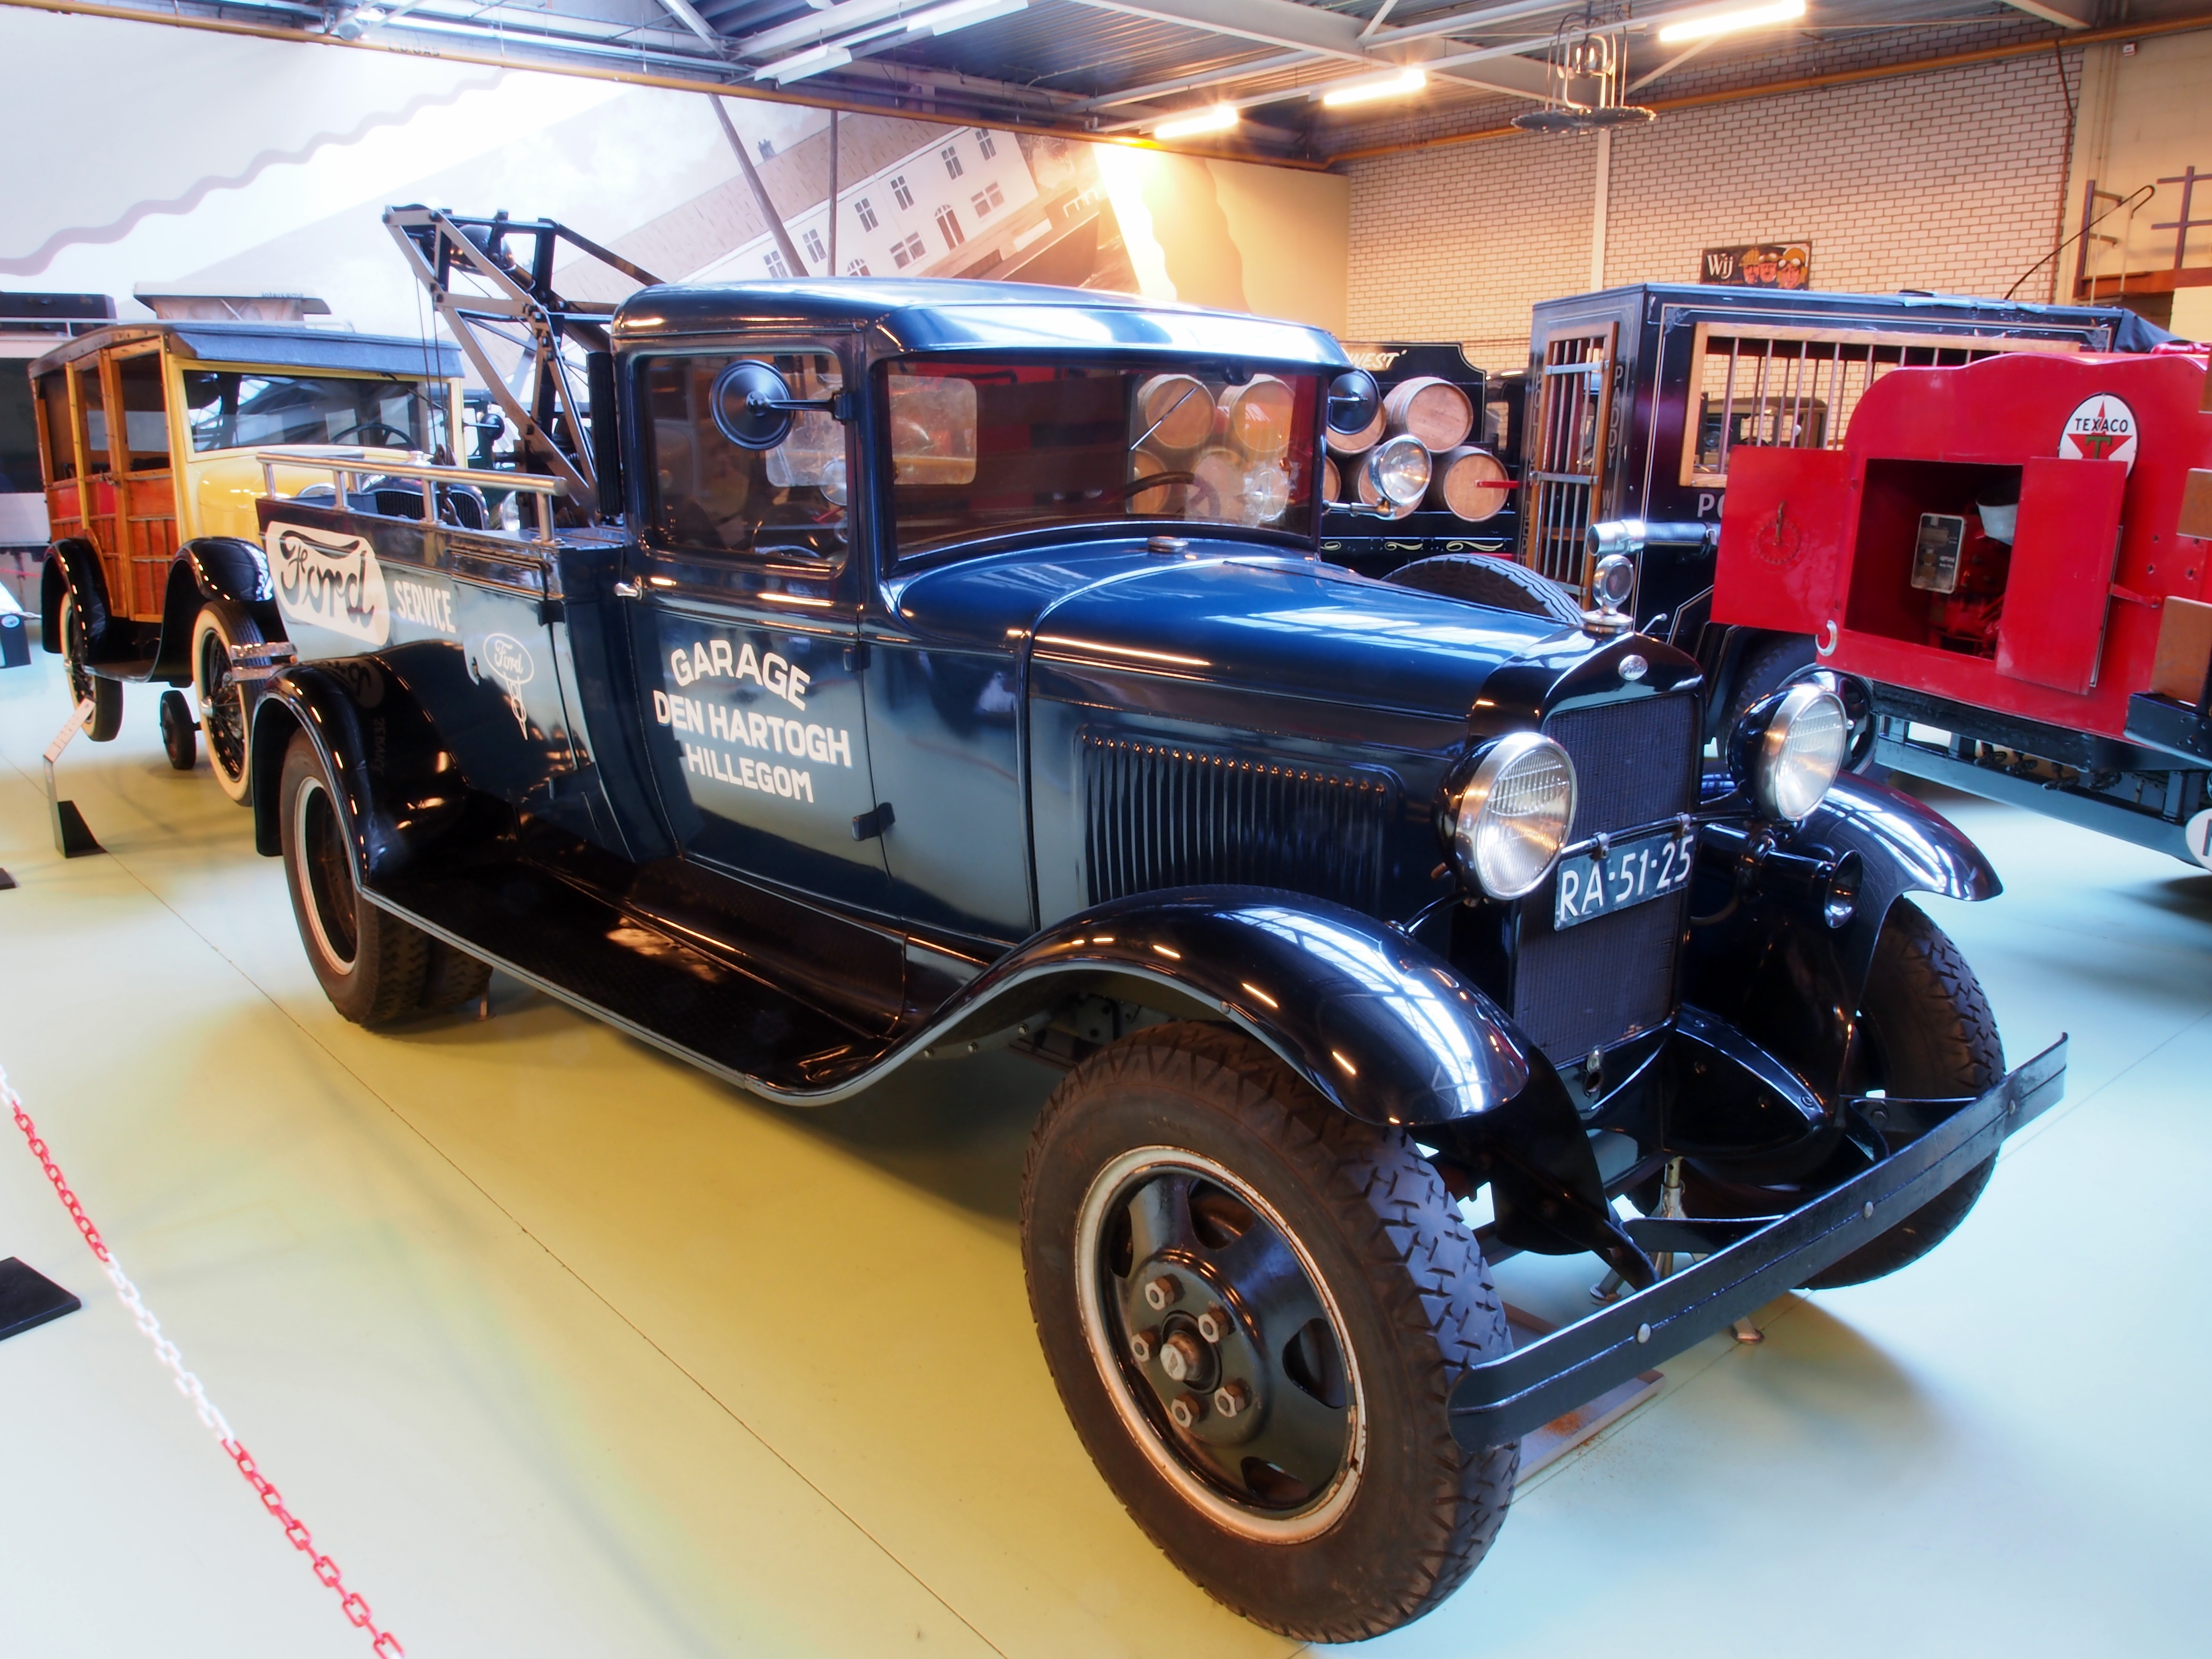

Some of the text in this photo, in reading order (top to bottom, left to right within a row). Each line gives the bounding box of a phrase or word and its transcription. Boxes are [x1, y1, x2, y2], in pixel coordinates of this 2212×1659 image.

[1707, 252, 1734, 280] Wij
[1608, 365, 1623, 469] PADDY
[2075, 418, 2128, 433] TEXACO
[279, 529, 456, 634] Ford SERVICE
[494, 639, 524, 674] Ford
[671, 639, 811, 711] GARAGE
[653, 690, 853, 768] DEN HARTOGH
[685, 743, 814, 804] HILLEGOM
